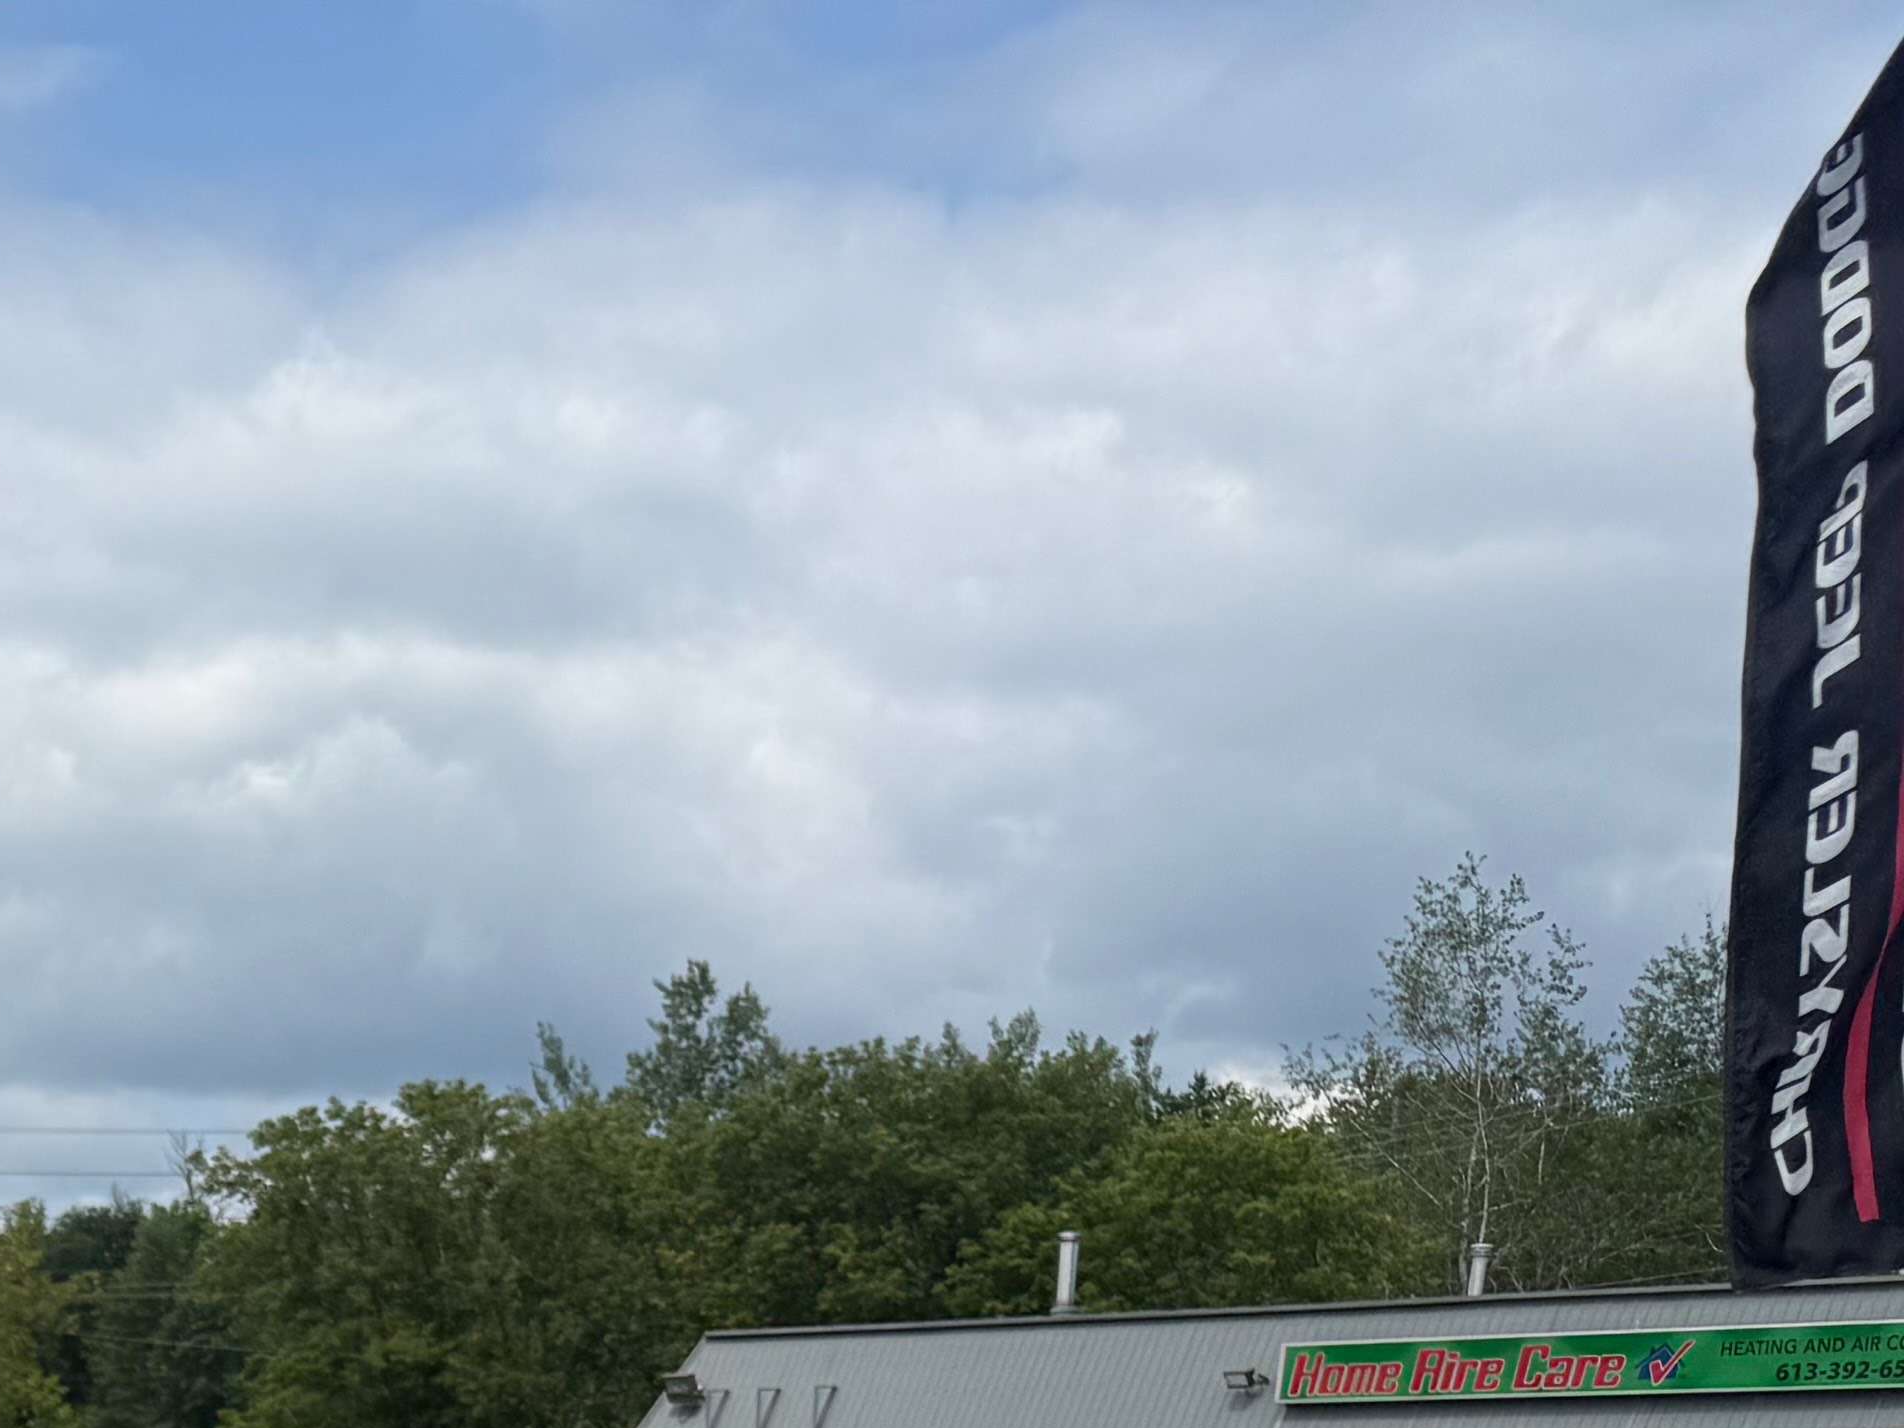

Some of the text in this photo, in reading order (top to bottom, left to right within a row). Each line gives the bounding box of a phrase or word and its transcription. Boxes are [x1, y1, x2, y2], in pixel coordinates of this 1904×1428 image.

[1720, 1338, 1797, 1357] HEATING
[1803, 1337, 1845, 1354] AND
[1851, 1335, 1880, 1352] AIR
[1287, 1343, 1627, 1398] Home Aire Care
